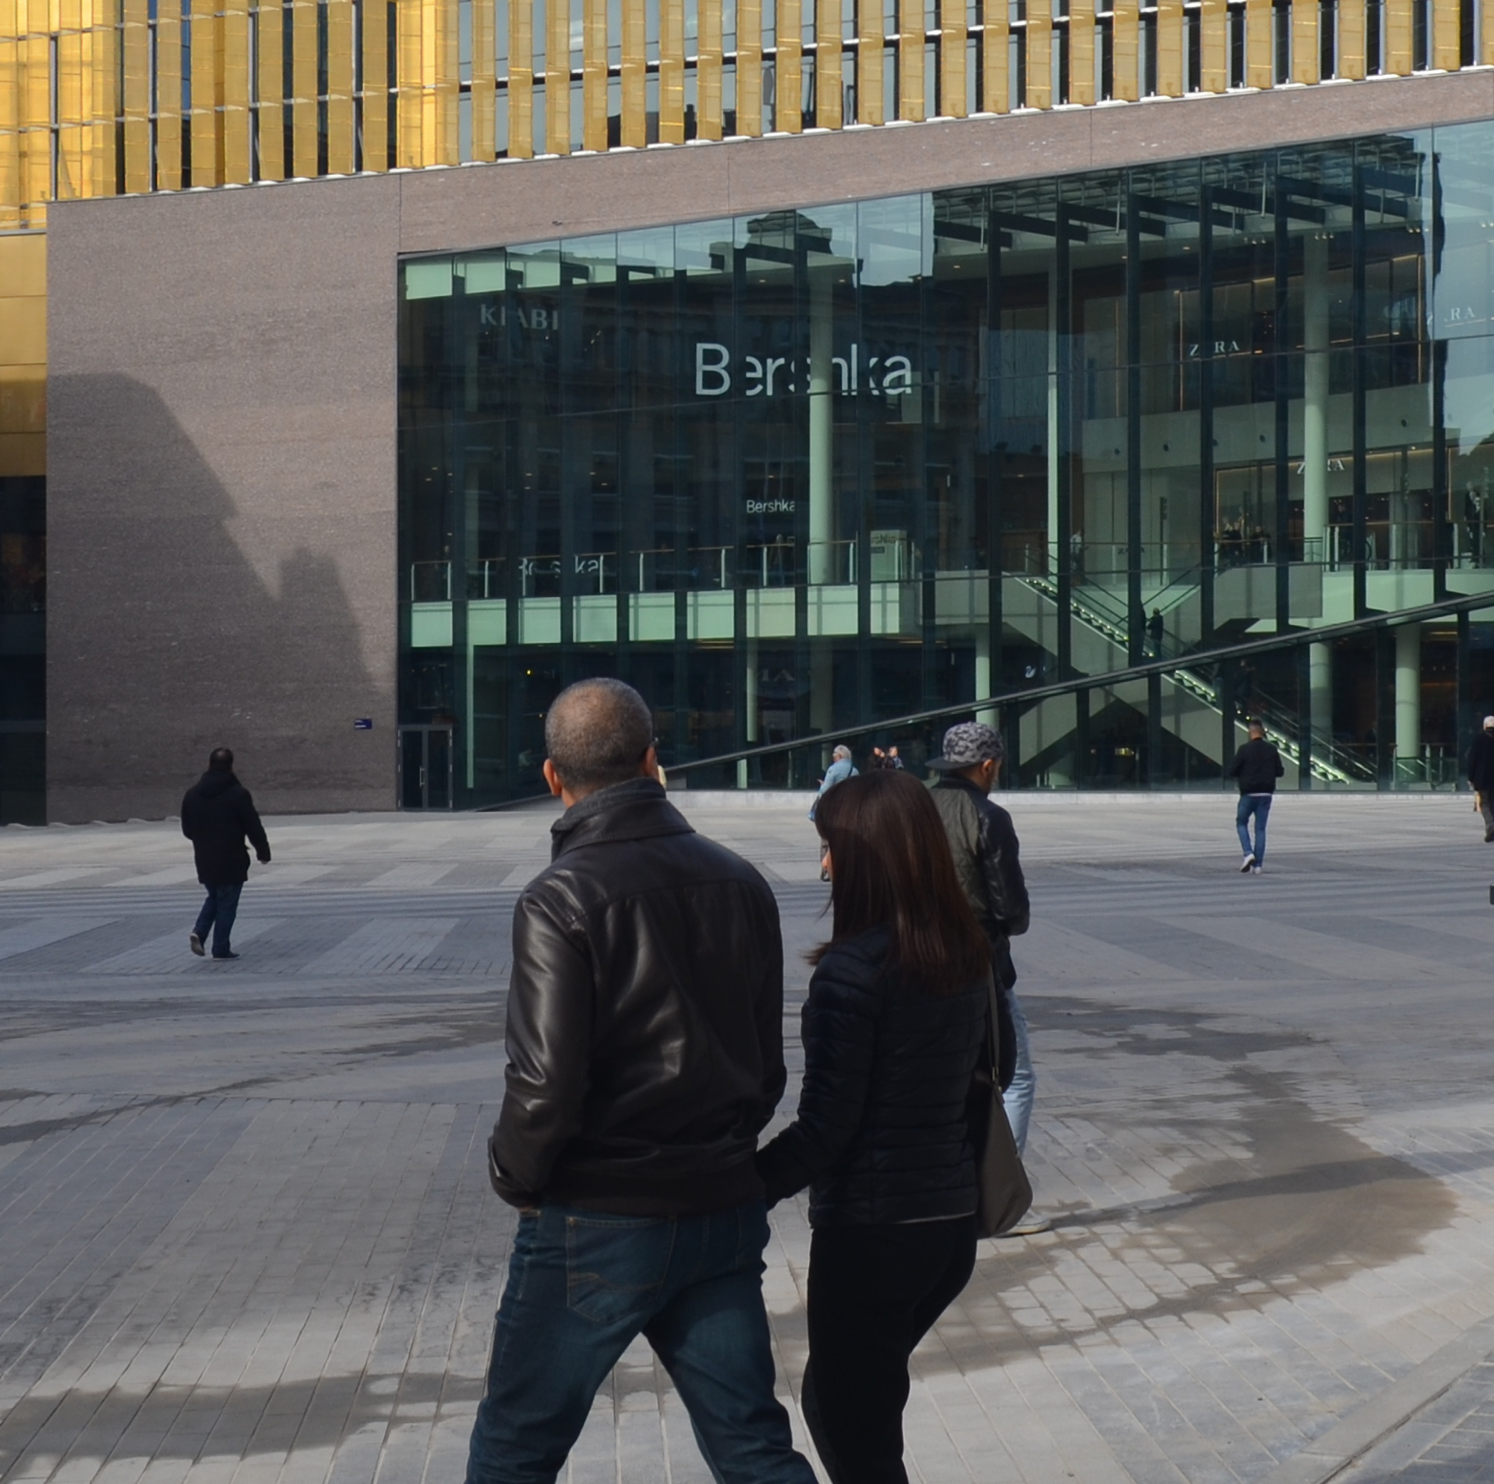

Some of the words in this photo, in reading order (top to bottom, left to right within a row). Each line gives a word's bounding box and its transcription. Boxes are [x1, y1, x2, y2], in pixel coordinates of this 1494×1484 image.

[1424, 306, 1476, 326] ZRA
[1189, 339, 1241, 356] ZRA
[1296, 458, 1345, 475] ZRA
[746, 498, 796, 515] Bershka
